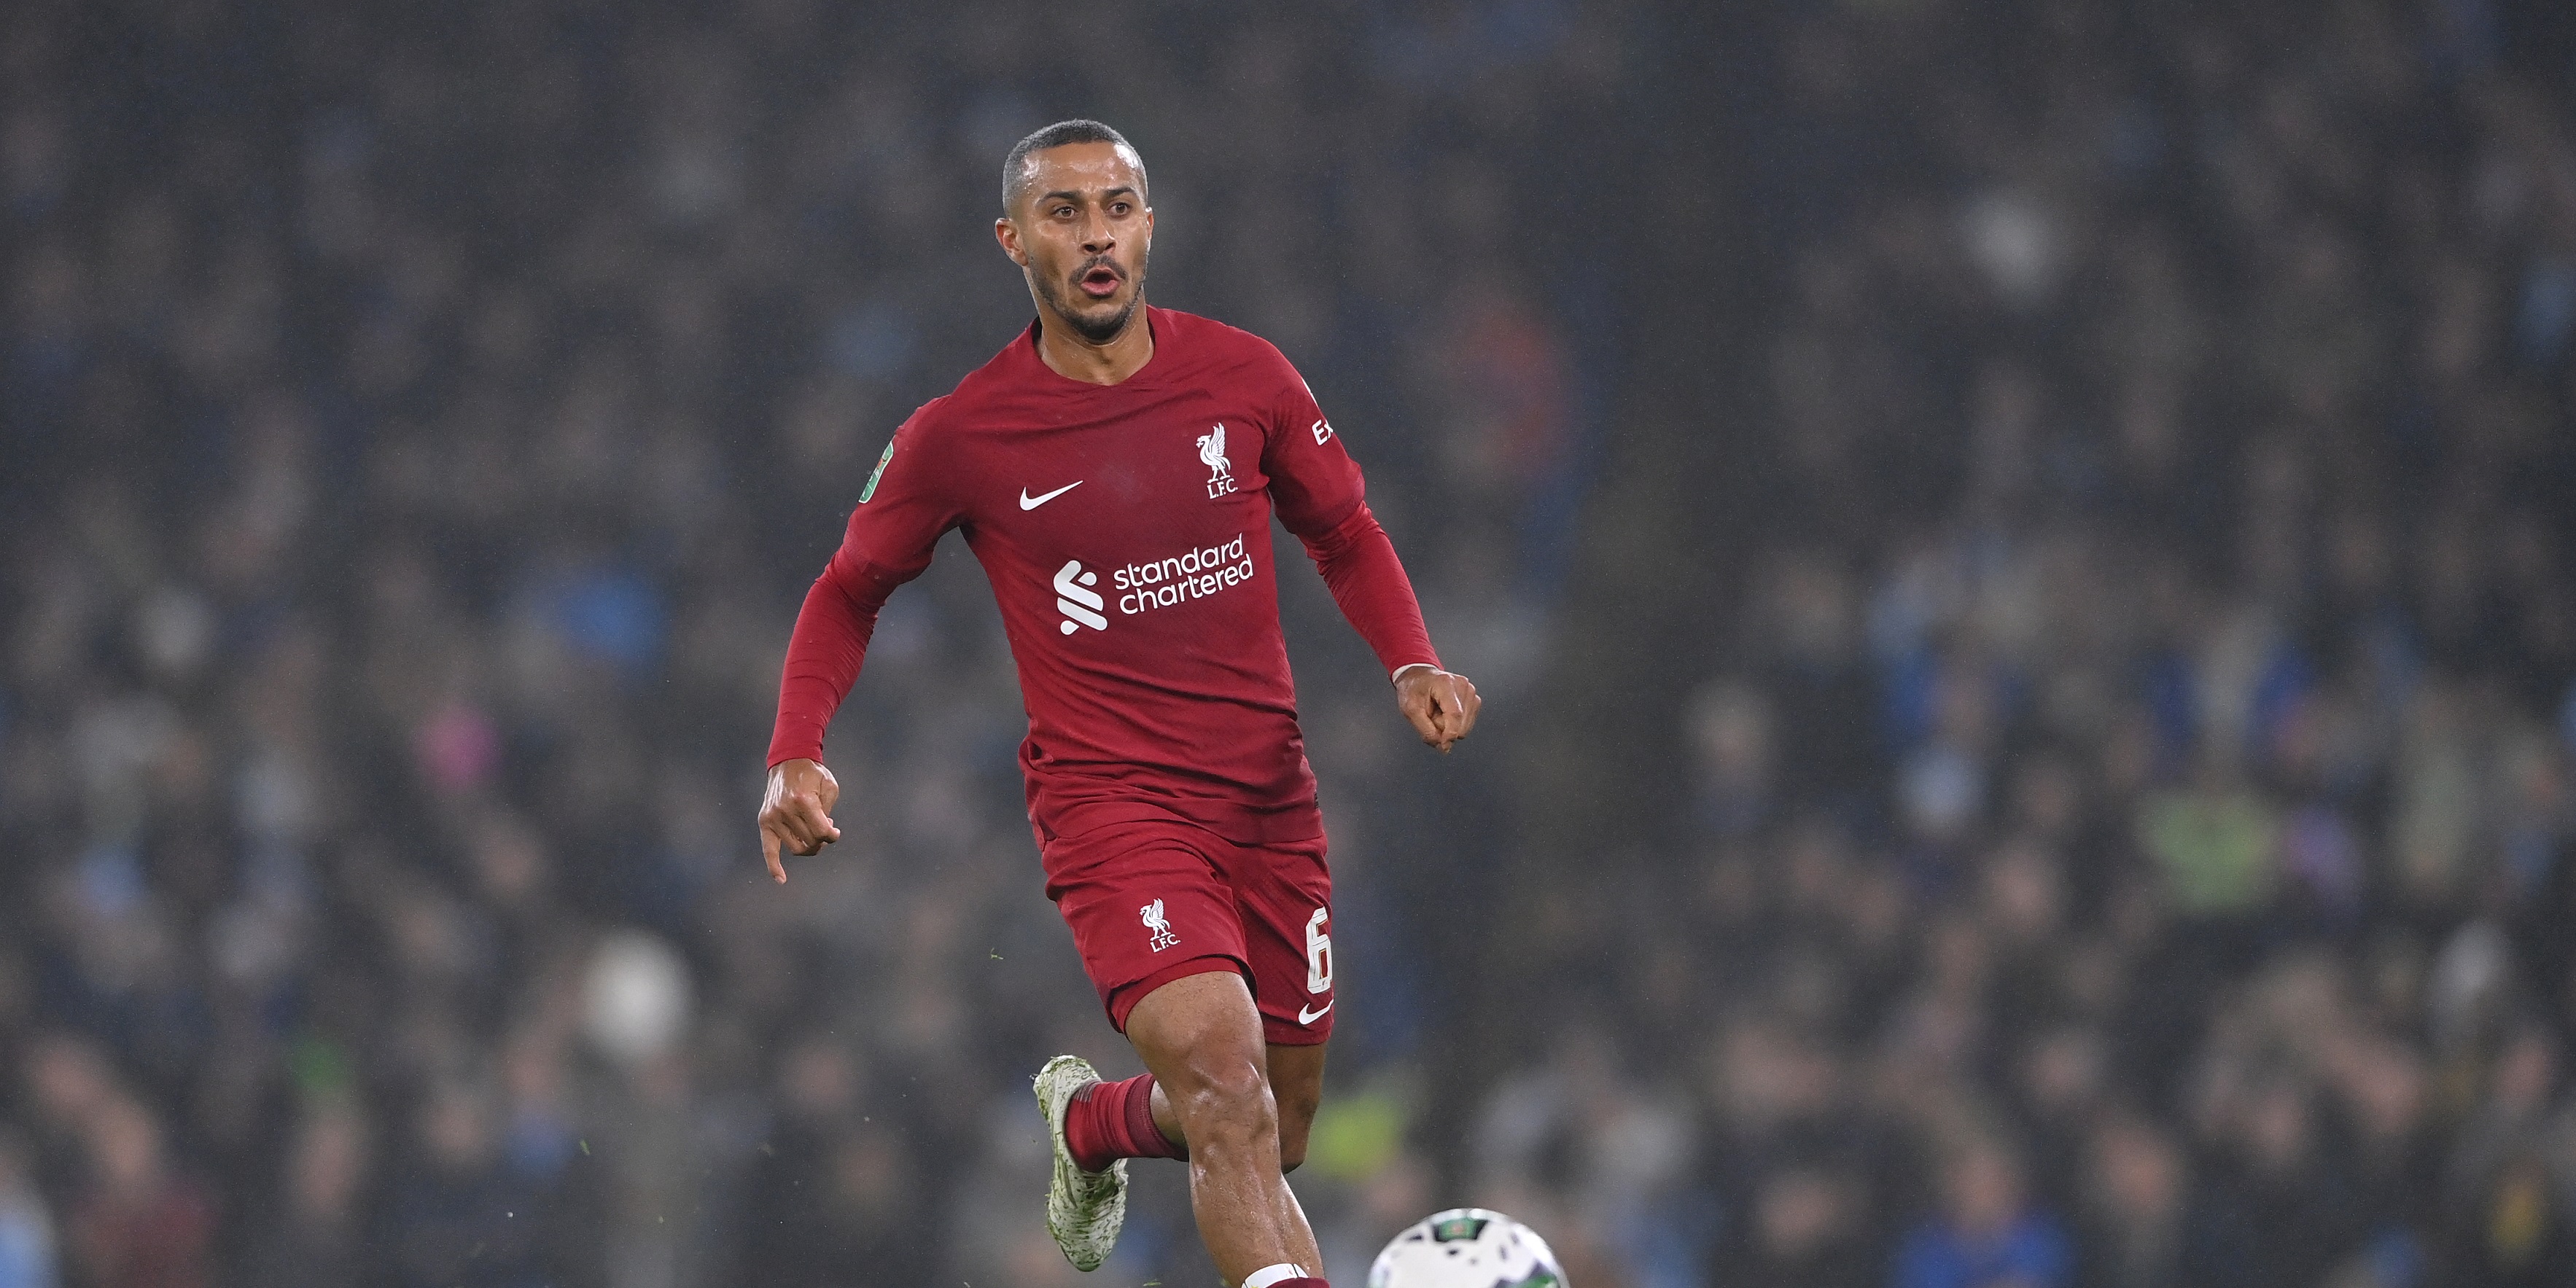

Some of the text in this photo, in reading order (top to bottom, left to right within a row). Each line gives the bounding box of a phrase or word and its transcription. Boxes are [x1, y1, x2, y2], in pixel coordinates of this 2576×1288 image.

[1207, 478, 1238, 499] L.F.C.
[1113, 532, 1243, 590] standard
[1119, 553, 1253, 614] chartered
[1305, 906, 1333, 994] 6
